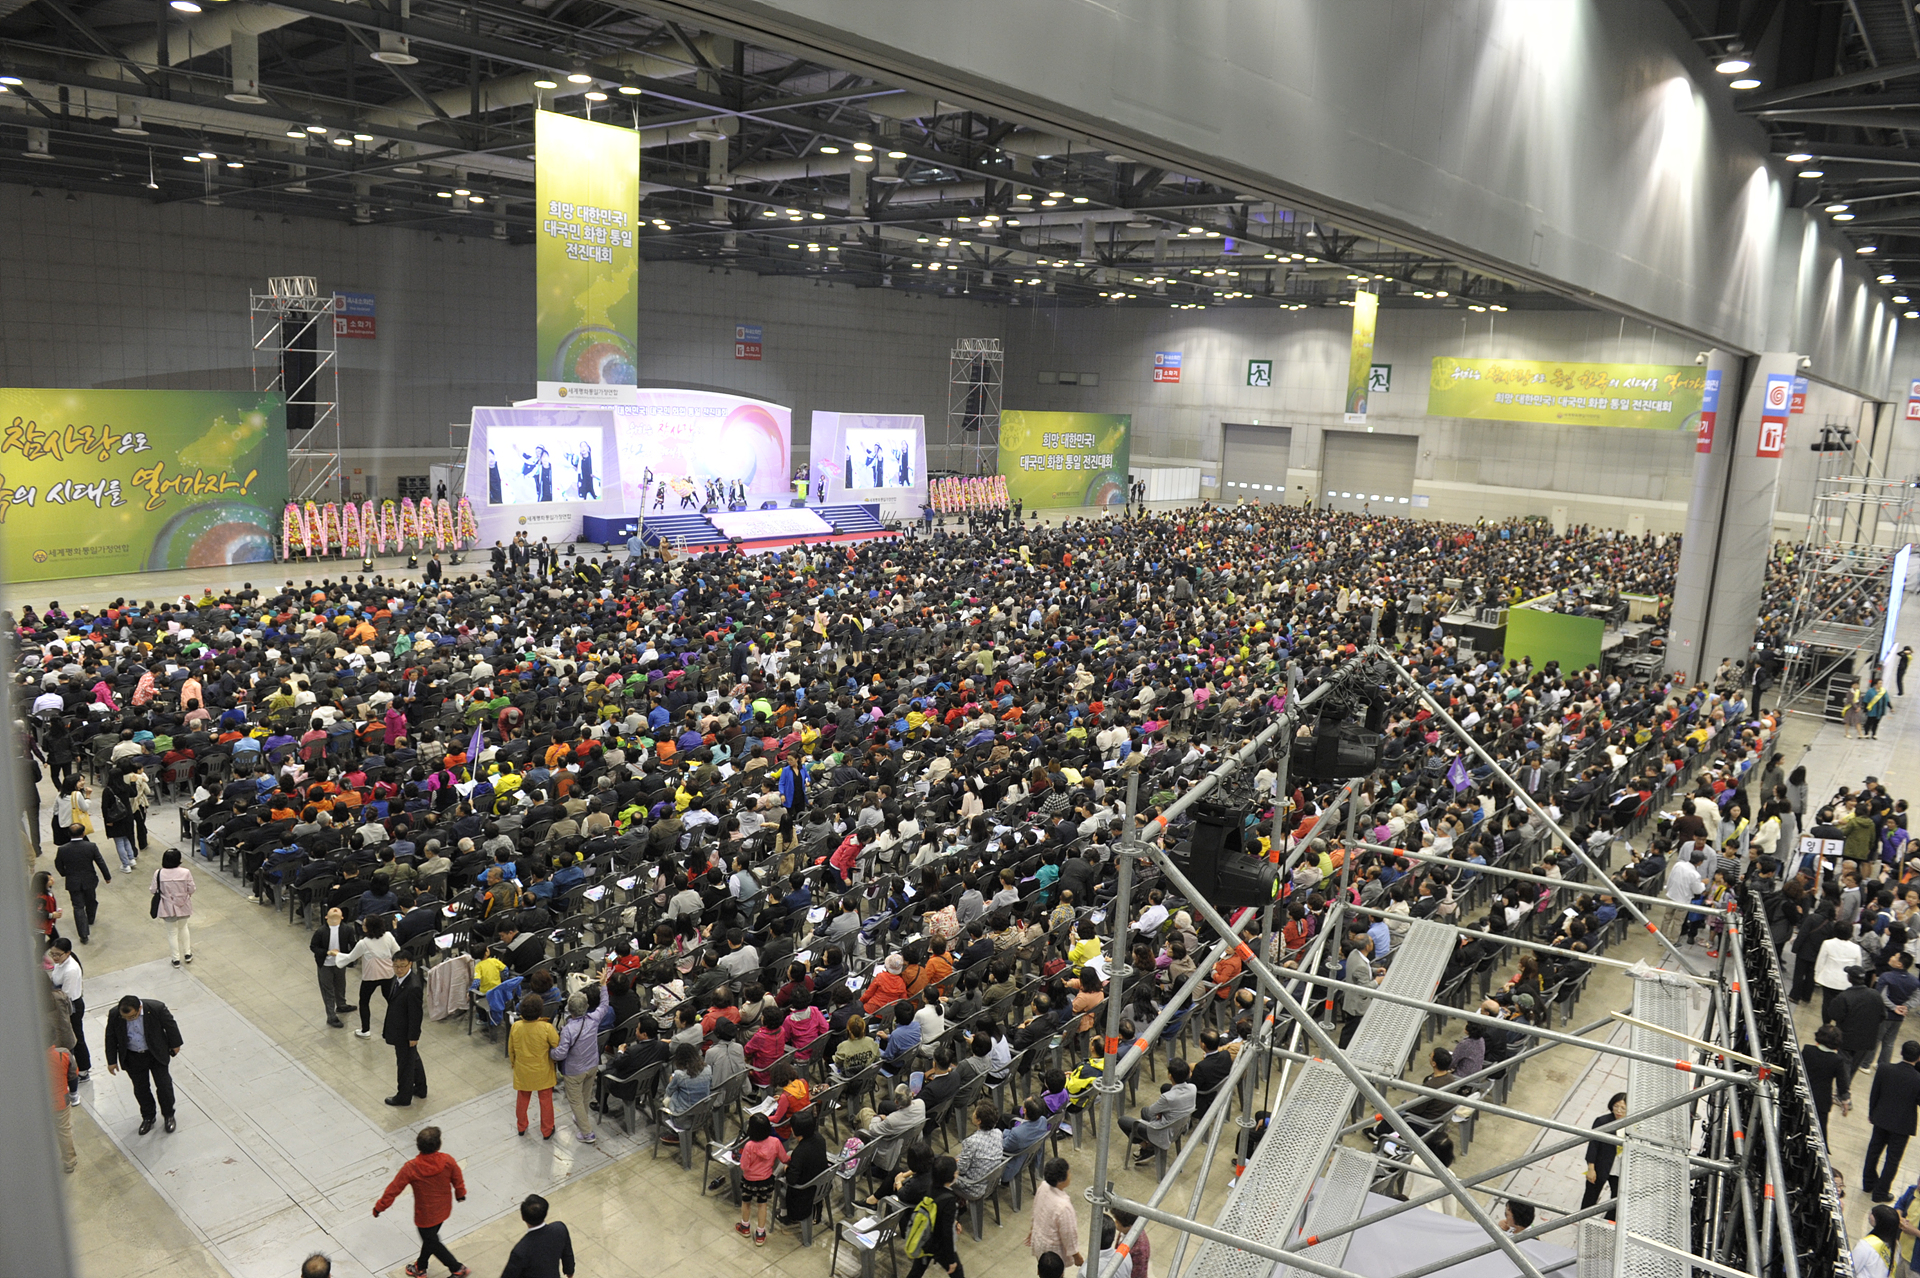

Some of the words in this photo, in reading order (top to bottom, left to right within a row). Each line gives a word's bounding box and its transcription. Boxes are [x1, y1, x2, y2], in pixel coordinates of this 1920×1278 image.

[548, 200, 575, 220] 희망
[576, 205, 627, 228] 대한민국!
[543, 219, 581, 241] 대국민
[583, 225, 608, 245] 화합
[609, 228, 633, 248] 통일
[565, 242, 613, 264] 전진대회
[350, 320, 372, 328] 소화기
[1450, 366, 1482, 381] 위하는
[1485, 364, 1547, 386] 참사랑으로
[1550, 368, 1576, 391] 통일
[1578, 369, 1620, 395] 한국의
[1622, 376, 1660, 392] 시대를
[1495, 392, 1514, 404] 희망
[1515, 393, 1556, 406] 대한민국!
[1557, 395, 1586, 408] 대국민
[1587, 396, 1608, 410] 화합
[1610, 397, 1630, 411] 통일
[1631, 399, 1672, 413] 전진대회
[1, 416, 152, 462] 참사랑으로
[1042, 432, 1060, 449] 희망
[1060, 432, 1096, 449] 대한민국!
[1019, 454, 1046, 471] 대국민
[1046, 453, 1064, 471] 화합
[1064, 454, 1081, 470] 통일
[1082, 453, 1113, 470] 전진대회
[45, 478, 127, 508] 시대를
[131, 460, 258, 511] 열어가자!
[48, 544, 129, 557] 세계평화통일가정연합
[846, 1050, 873, 1062] SWAGGER
